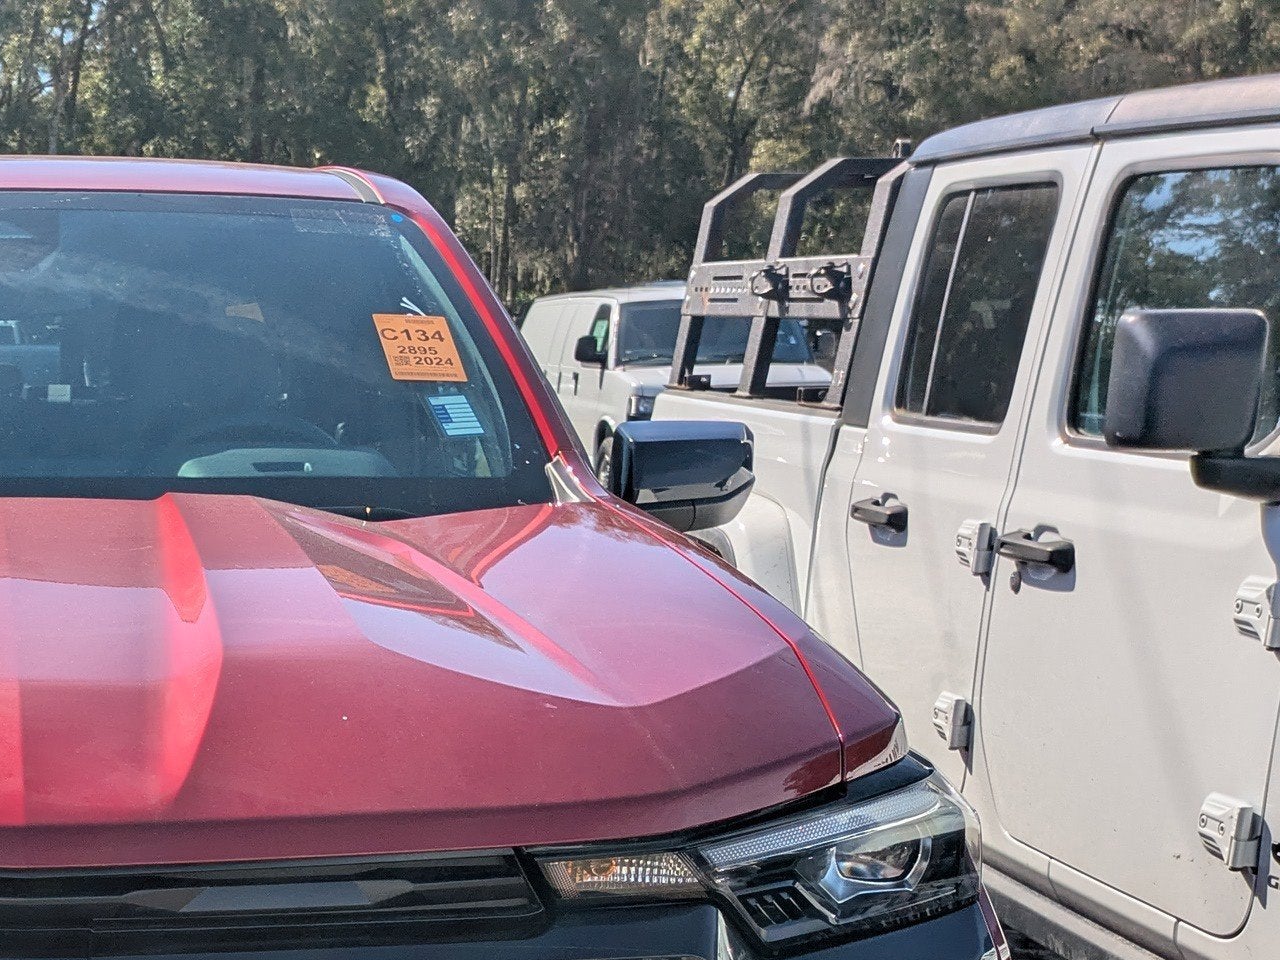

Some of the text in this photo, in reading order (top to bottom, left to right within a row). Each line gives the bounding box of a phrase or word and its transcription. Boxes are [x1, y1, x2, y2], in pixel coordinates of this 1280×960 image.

[380, 327, 445, 343] C134
[397, 345, 438, 356] 2895
[413, 356, 454, 367] 2024
